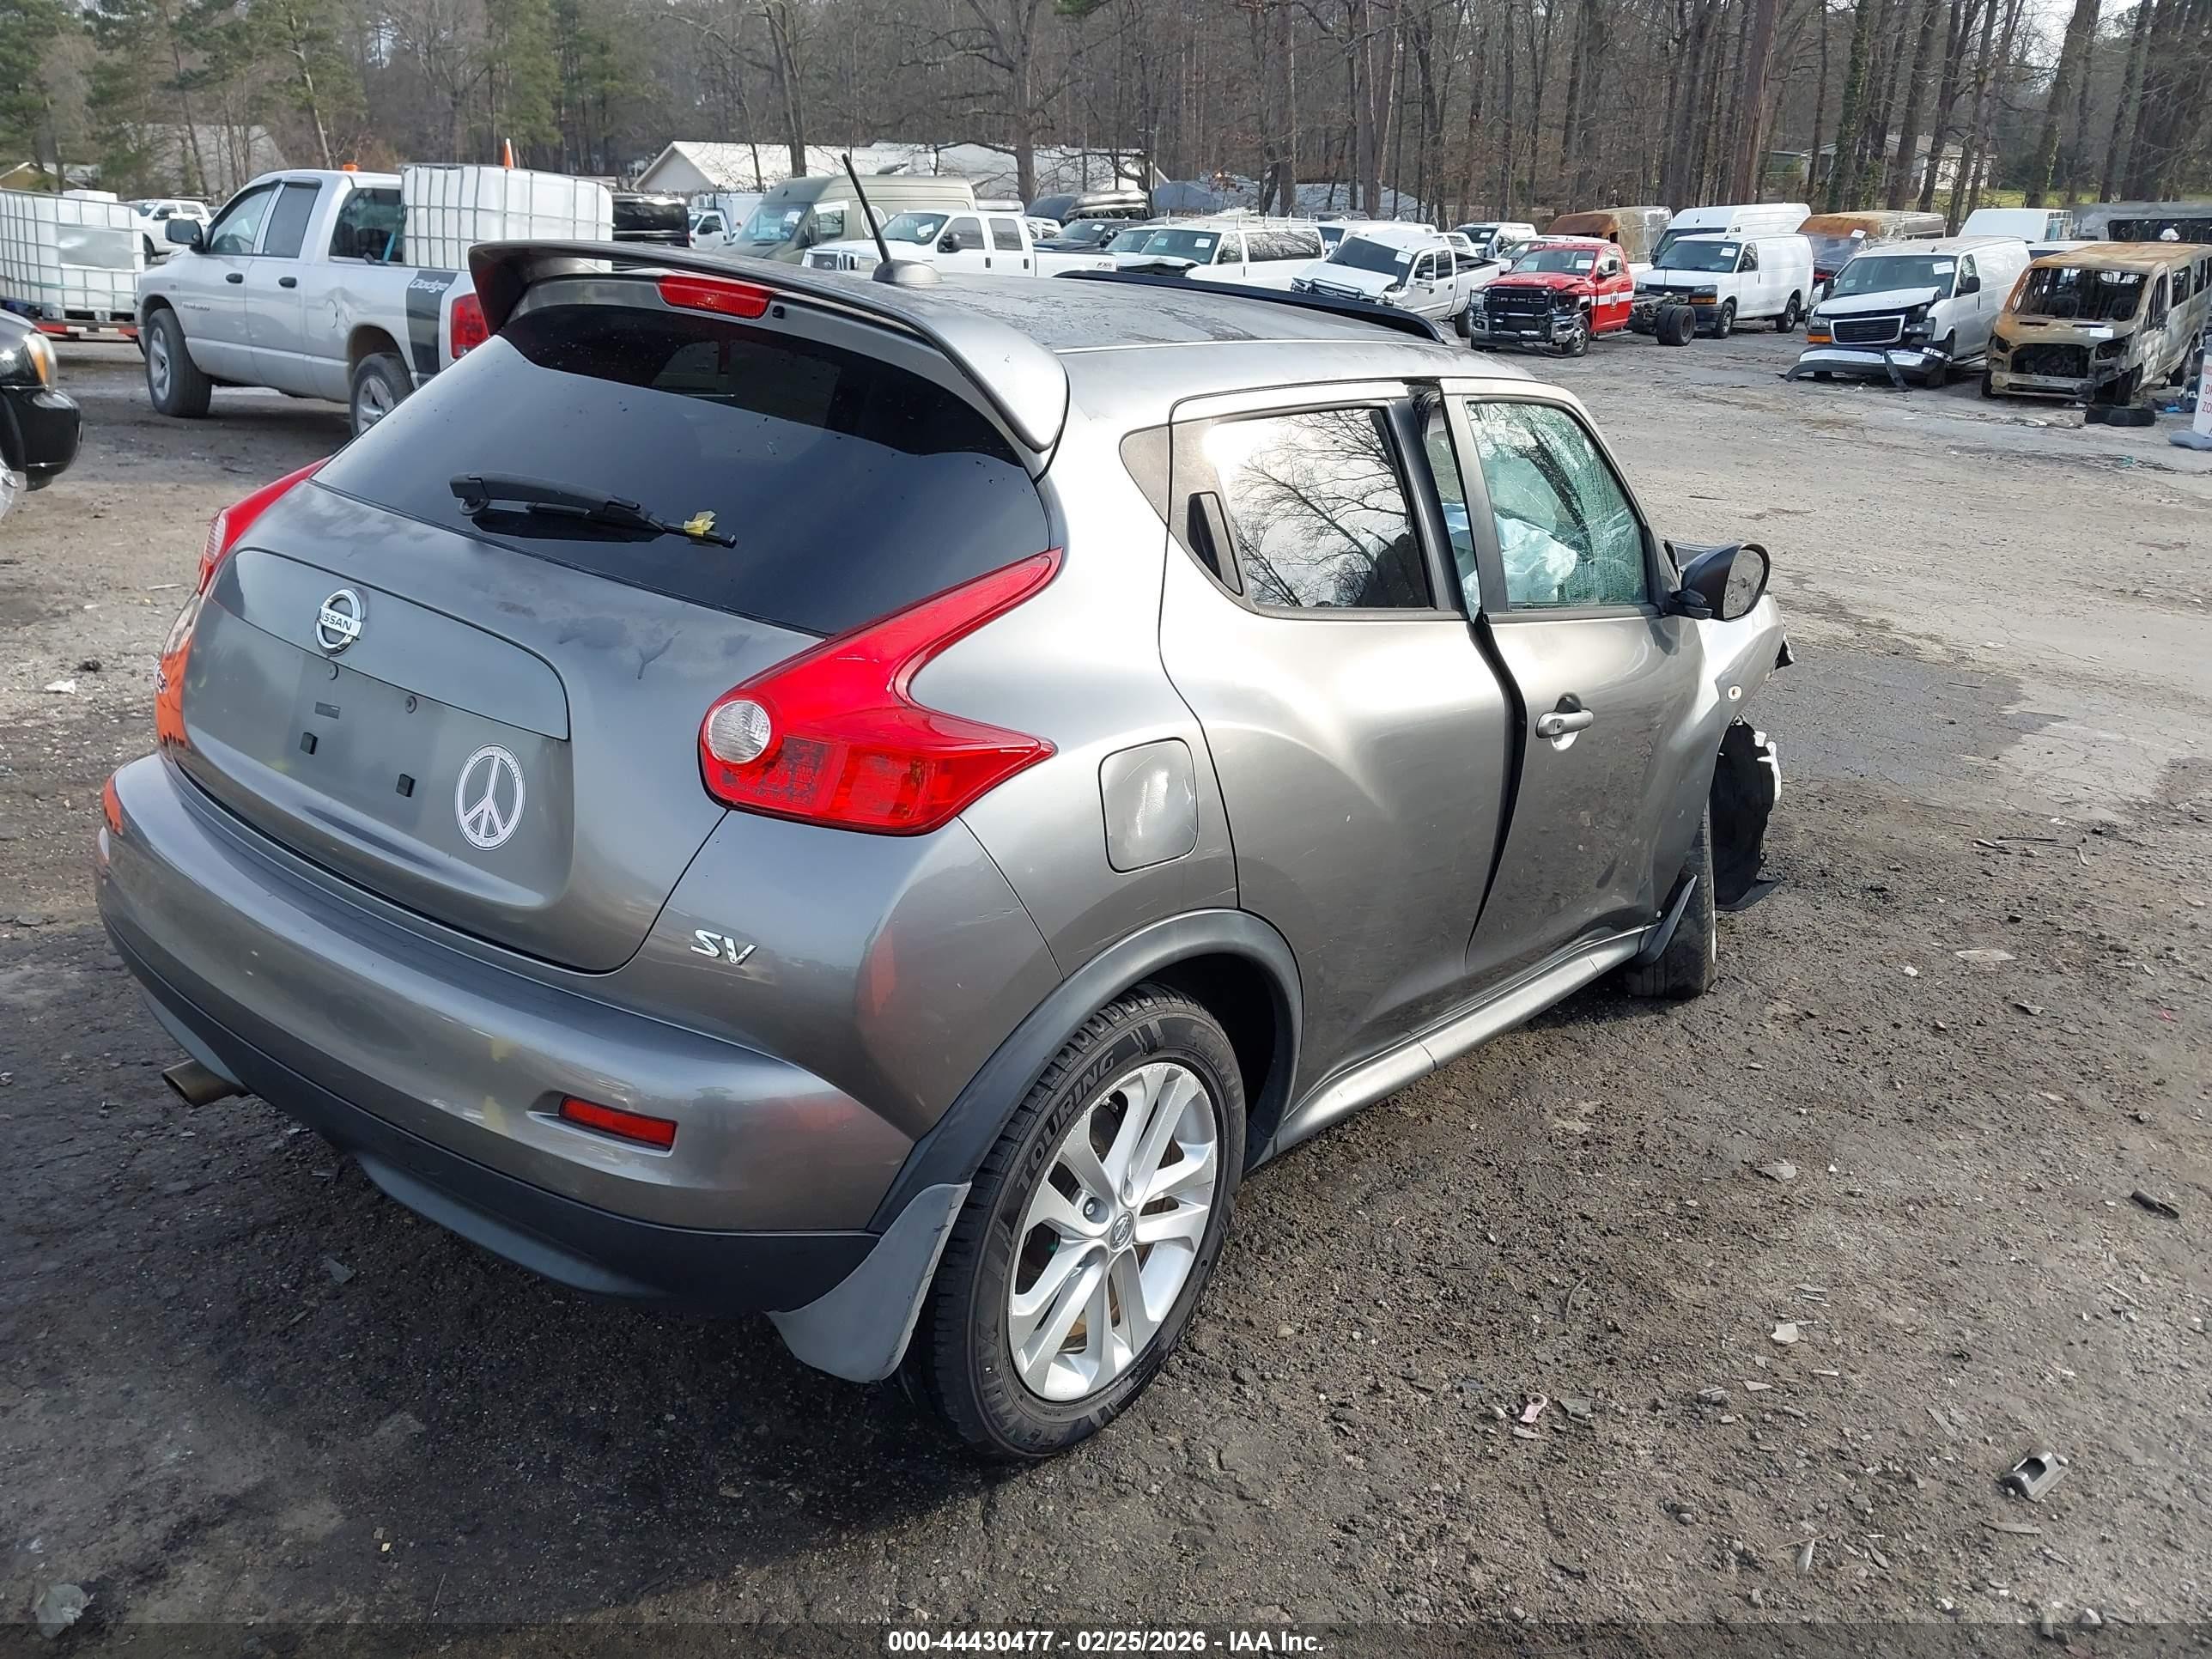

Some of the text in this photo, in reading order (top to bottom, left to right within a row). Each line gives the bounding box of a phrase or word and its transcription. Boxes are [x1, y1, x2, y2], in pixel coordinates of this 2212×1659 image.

[409, 278, 449, 294] Dodge
[2202, 400, 2212, 414] ZO
[690, 929, 757, 965] SV
[1016, 1049, 1115, 1191] TOURING
